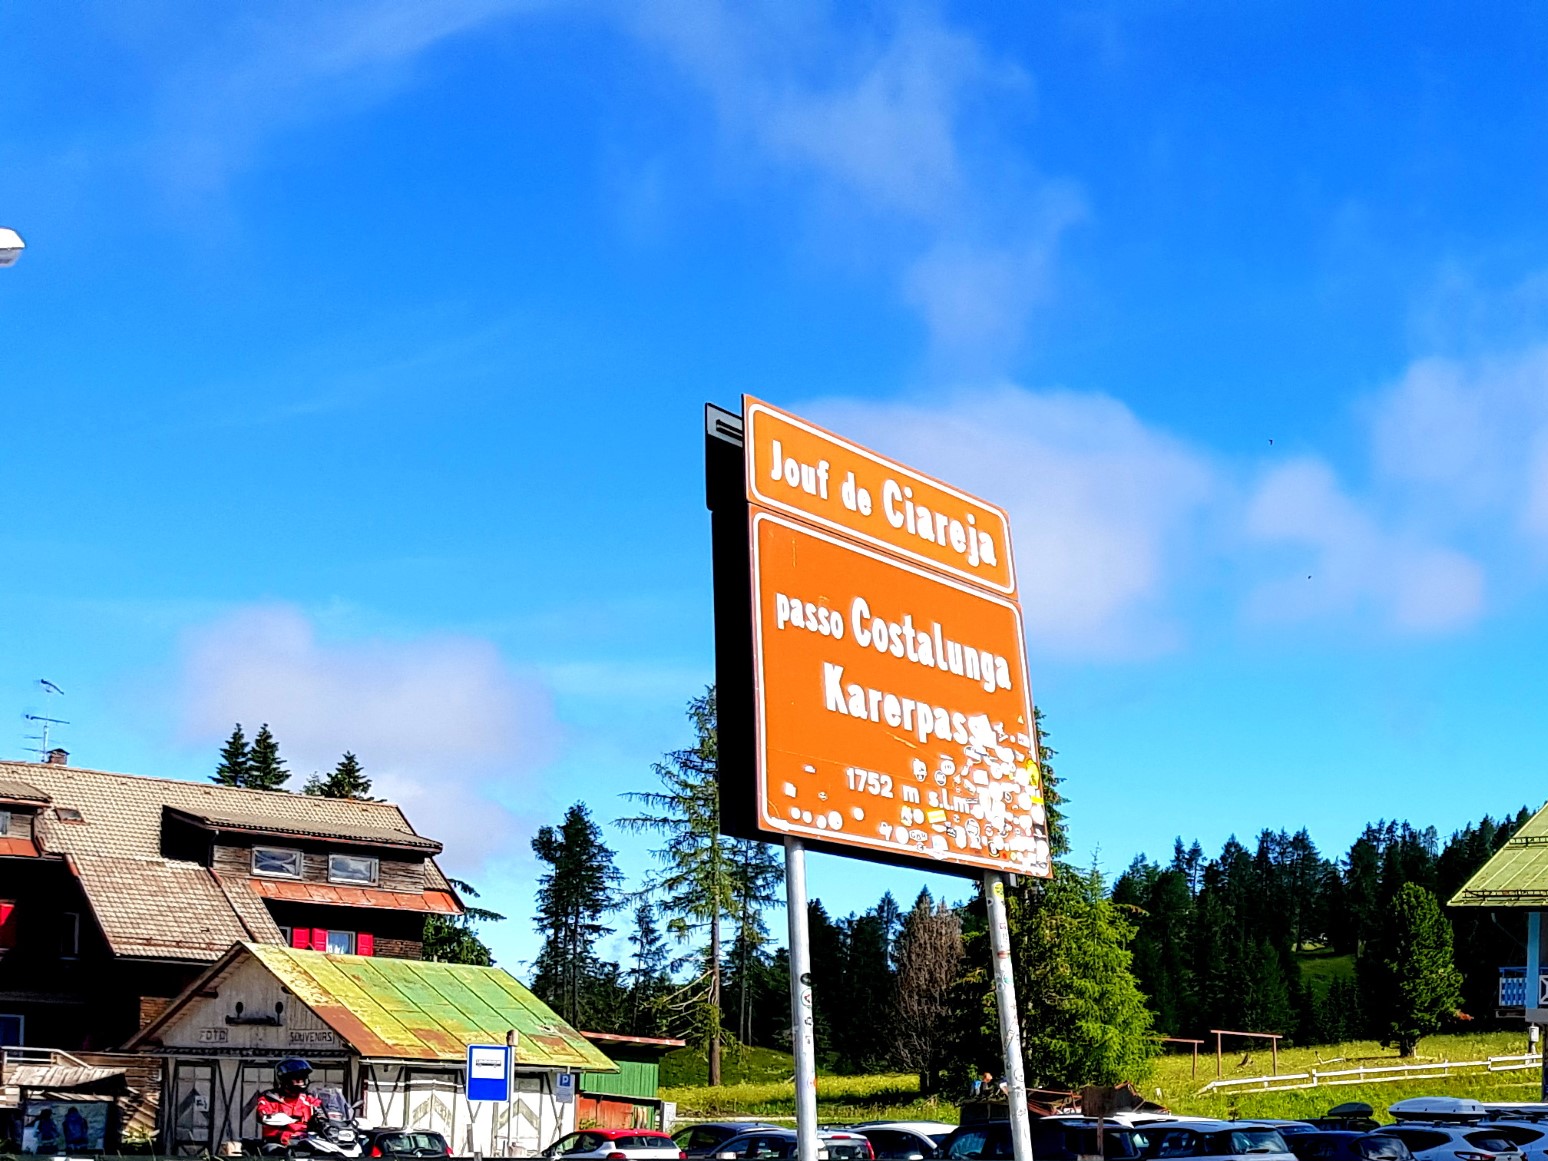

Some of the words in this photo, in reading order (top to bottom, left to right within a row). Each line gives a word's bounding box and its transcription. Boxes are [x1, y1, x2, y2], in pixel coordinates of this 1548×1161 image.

[770, 439, 831, 498] Jouf
[840, 469, 873, 517] de
[881, 478, 998, 569] Ciareja
[776, 591, 845, 641] passo
[850, 595, 1013, 693] Costalunga
[845, 766, 895, 799] 1752
[902, 784, 921, 804] m
[199, 1030, 226, 1041] FOTO
[289, 1031, 333, 1042] SOUVENIRS
